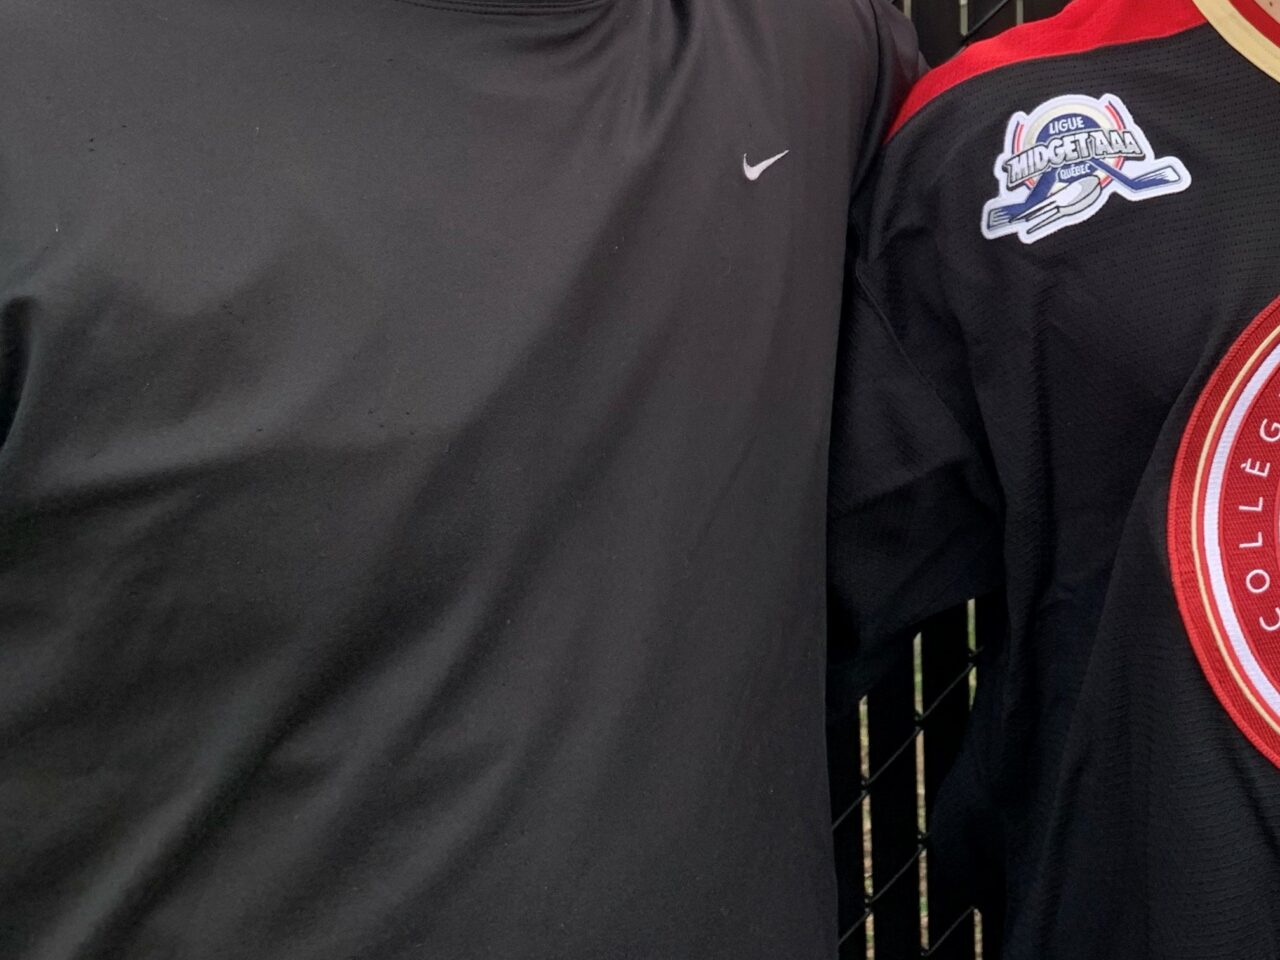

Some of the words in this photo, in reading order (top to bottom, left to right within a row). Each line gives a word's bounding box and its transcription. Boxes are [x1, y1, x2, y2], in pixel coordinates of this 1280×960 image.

[1049, 115, 1085, 134] LIGUE
[1006, 131, 1091, 184] MIDGET
[1091, 129, 1144, 158] AAA
[1059, 162, 1091, 180] QUÉBEC
